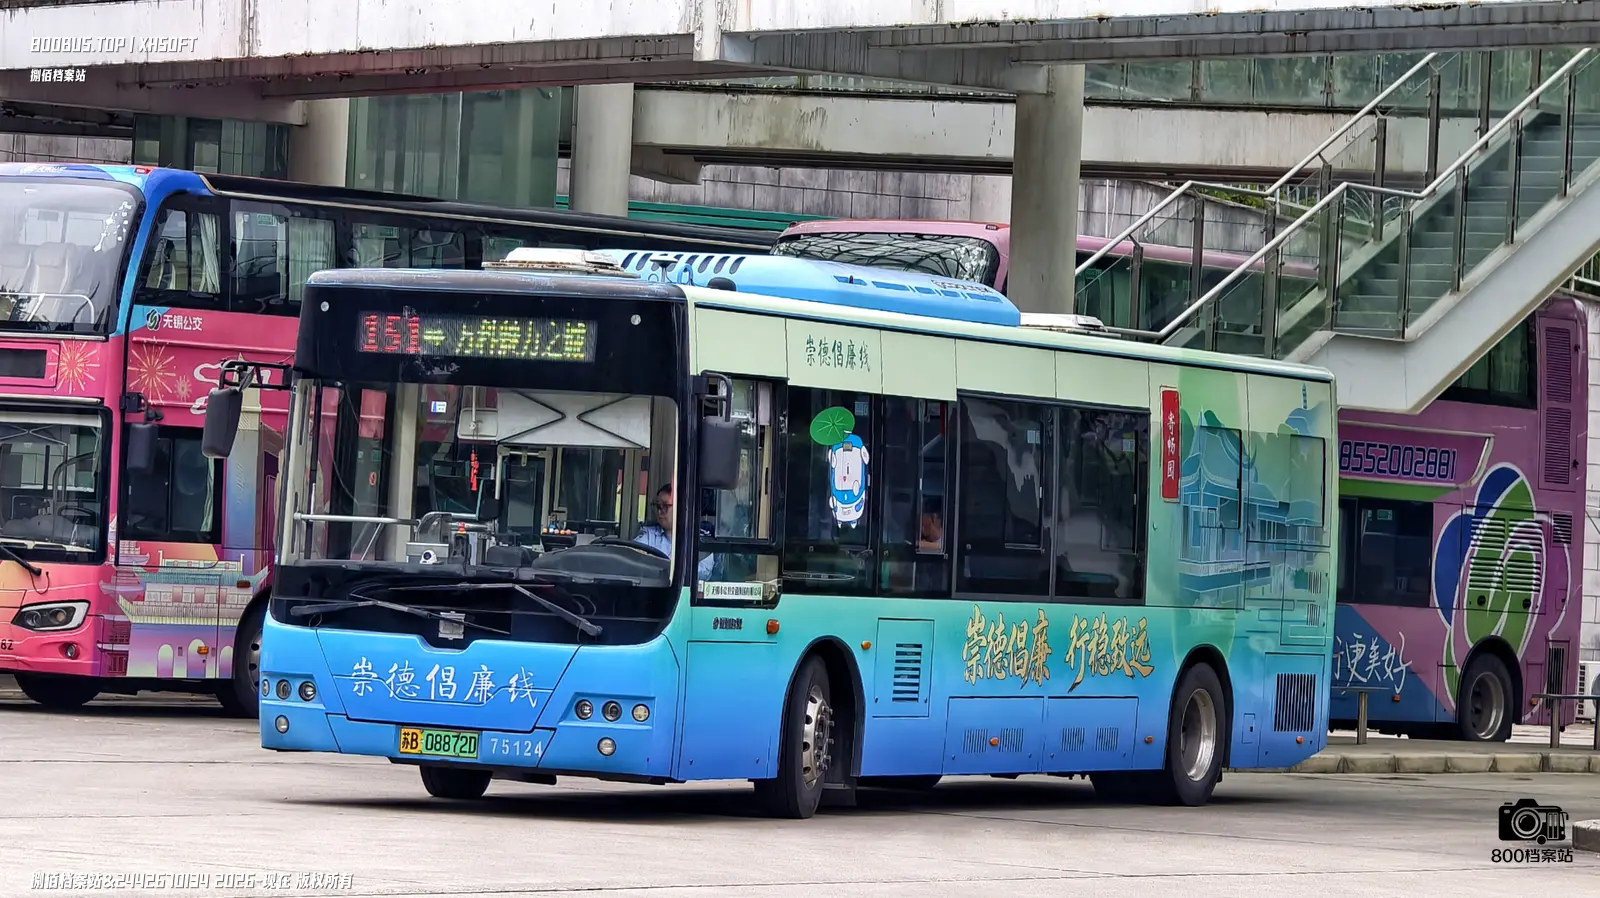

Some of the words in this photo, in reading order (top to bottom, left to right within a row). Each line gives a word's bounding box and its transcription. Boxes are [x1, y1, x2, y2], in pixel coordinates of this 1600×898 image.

[162, 314, 203, 331] 无锡公交
[362, 314, 421, 353] 151
[805, 334, 871, 373] 崇德倡廉线
[1339, 441, 1457, 480] 8552002881
[962, 604, 1052, 689] 崇德倡廉
[1064, 612, 1154, 694] 行稳致远
[351, 657, 538, 709] 崇德倡廉线
[490, 738, 543, 757] 75124
